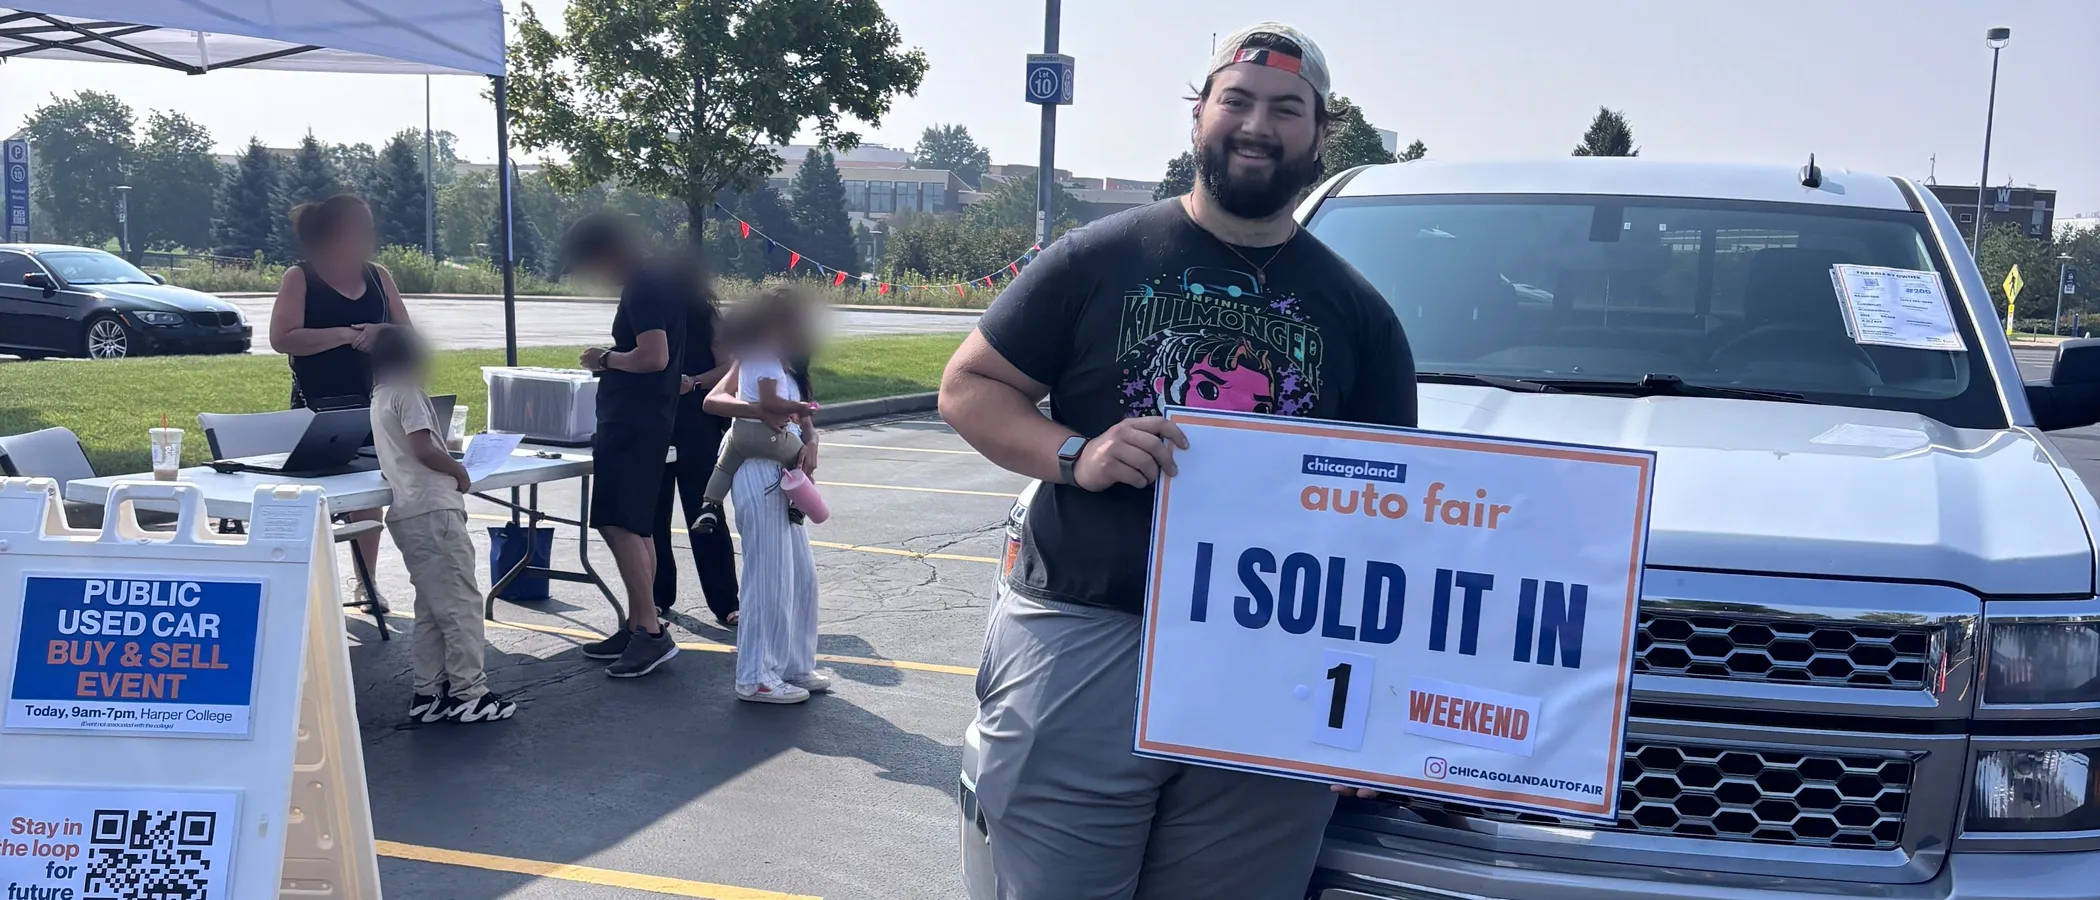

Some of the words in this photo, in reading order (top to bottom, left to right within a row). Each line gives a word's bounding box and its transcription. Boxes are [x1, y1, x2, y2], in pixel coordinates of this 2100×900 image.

[1034, 79, 1052, 94] 10
[14, 146, 21, 158] P
[14, 171, 23, 179] 10
[1997, 188, 2010, 202] W
[1186, 292, 1262, 314] INFINITY
[1116, 295, 1324, 400] KILLMONGER
[1306, 458, 1399, 480] chicagoland
[1300, 484, 1408, 520] auto
[1423, 482, 1512, 529] fair
[83, 580, 202, 608] PUBLIC
[1190, 542, 1214, 622] I
[1233, 547, 1406, 645] SOLD
[1428, 568, 1494, 655] IT
[1513, 577, 1588, 669] IN
[58, 610, 147, 636] USED
[152, 612, 220, 638] CAR
[47, 640, 115, 666] BUY
[120, 643, 142, 667] &
[149, 643, 228, 669] SELL
[76, 672, 187, 699] EVENT
[1326, 663, 1352, 729] 1
[1409, 689, 1530, 742] WEEKEND
[25, 705, 69, 719] Today,
[71, 706, 138, 721] 9am-7pm,
[140, 708, 183, 722] Harper
[186, 709, 233, 724] College
[1448, 764, 1603, 796] CHICAGOLANDAUTOFAIR
[10, 816, 60, 839] Stay
[63, 817, 83, 835] in
[32, 839, 80, 861] loop
[45, 861, 78, 879] for
[8, 882, 74, 900] future
